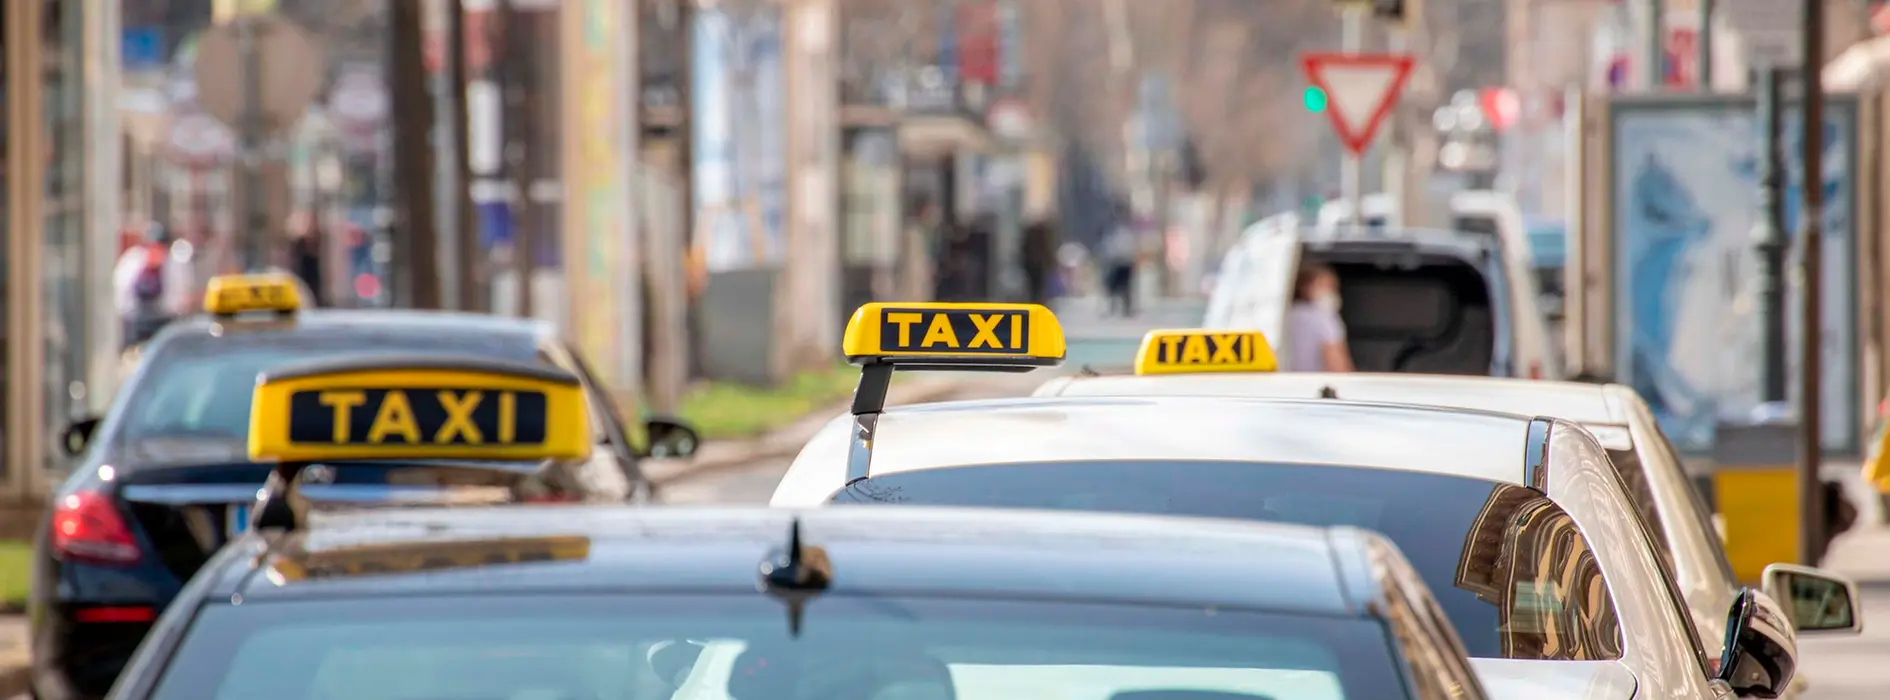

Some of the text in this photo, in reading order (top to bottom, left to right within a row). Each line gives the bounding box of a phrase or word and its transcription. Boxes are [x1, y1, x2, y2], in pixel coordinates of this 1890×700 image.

[887, 313, 1023, 349] TAXI
[1159, 334, 1251, 363] TAXI
[318, 389, 517, 445] TAXI
